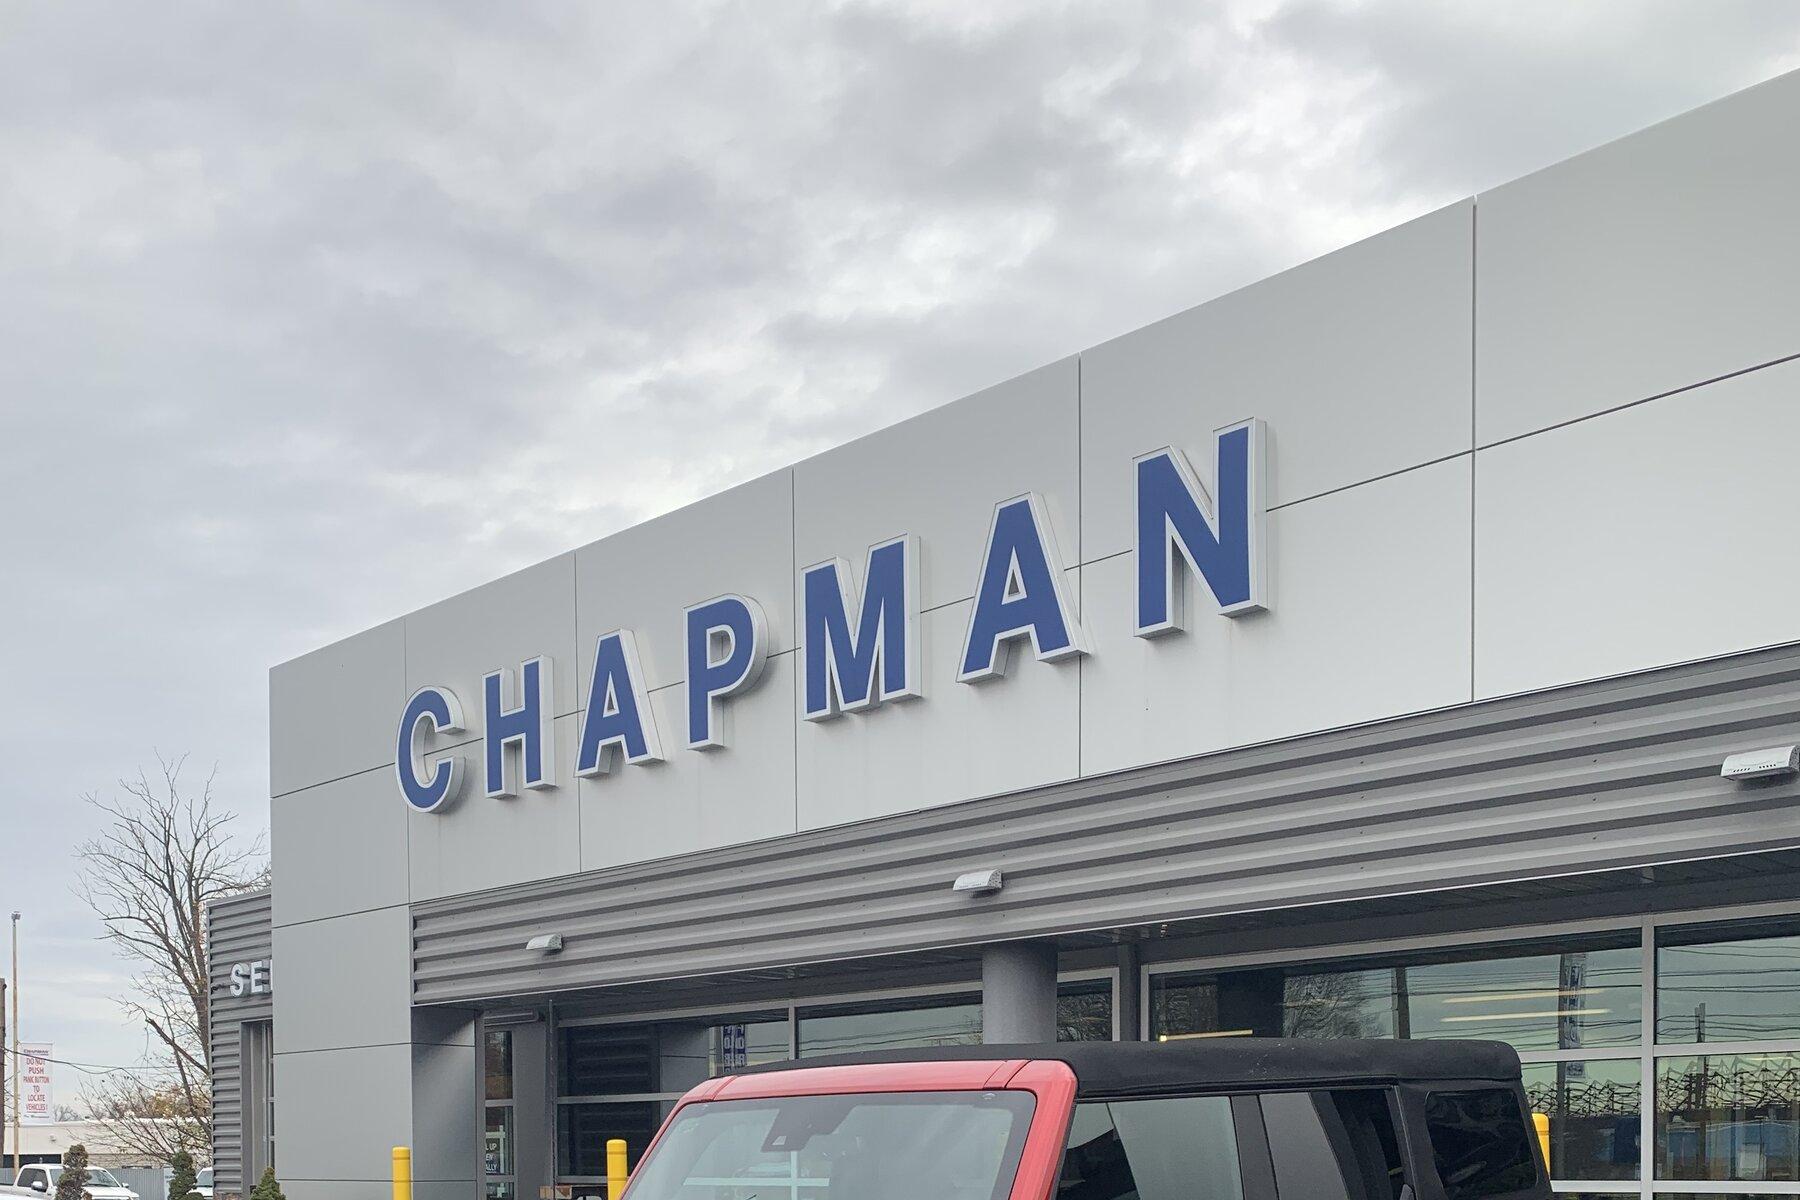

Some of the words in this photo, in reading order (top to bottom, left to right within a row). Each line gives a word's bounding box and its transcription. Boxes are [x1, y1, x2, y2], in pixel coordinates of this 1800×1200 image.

[395, 417, 1268, 813] CHAPMAN
[230, 959, 273, 996] SE
[28, 1066, 45, 1075] PUSH
[33, 1085, 41, 1093] TO
[27, 1094, 46, 1102] LOCATE
